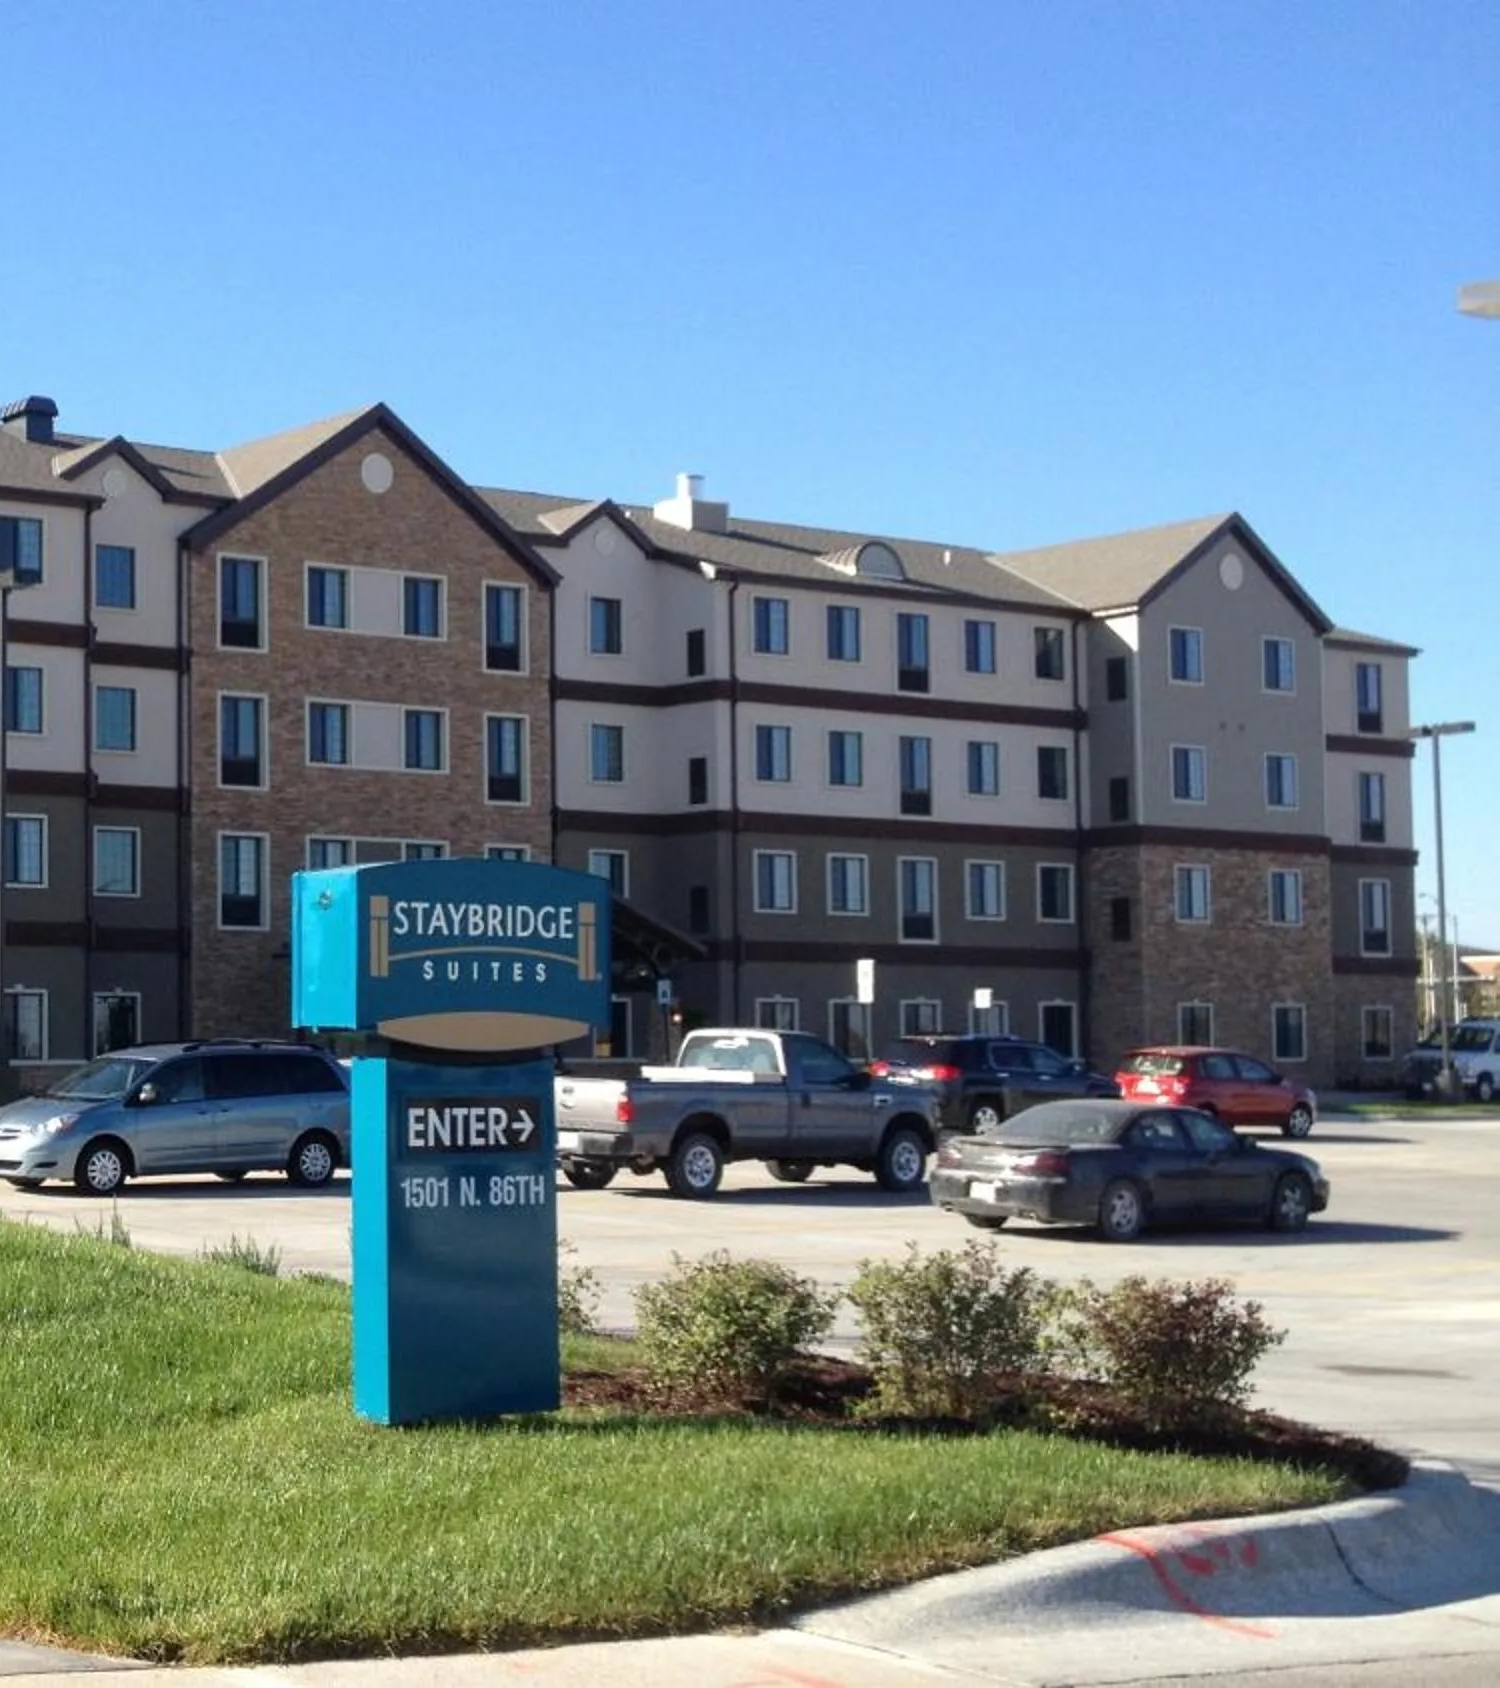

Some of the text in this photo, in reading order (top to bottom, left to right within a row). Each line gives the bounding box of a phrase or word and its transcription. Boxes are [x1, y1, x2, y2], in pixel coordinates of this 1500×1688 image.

[393, 901, 575, 940] STAYBRIDGE
[423, 960, 548, 982] SUITES
[407, 1106, 509, 1148] ENTER
[401, 1175, 545, 1208] 1501 N. 86TH
